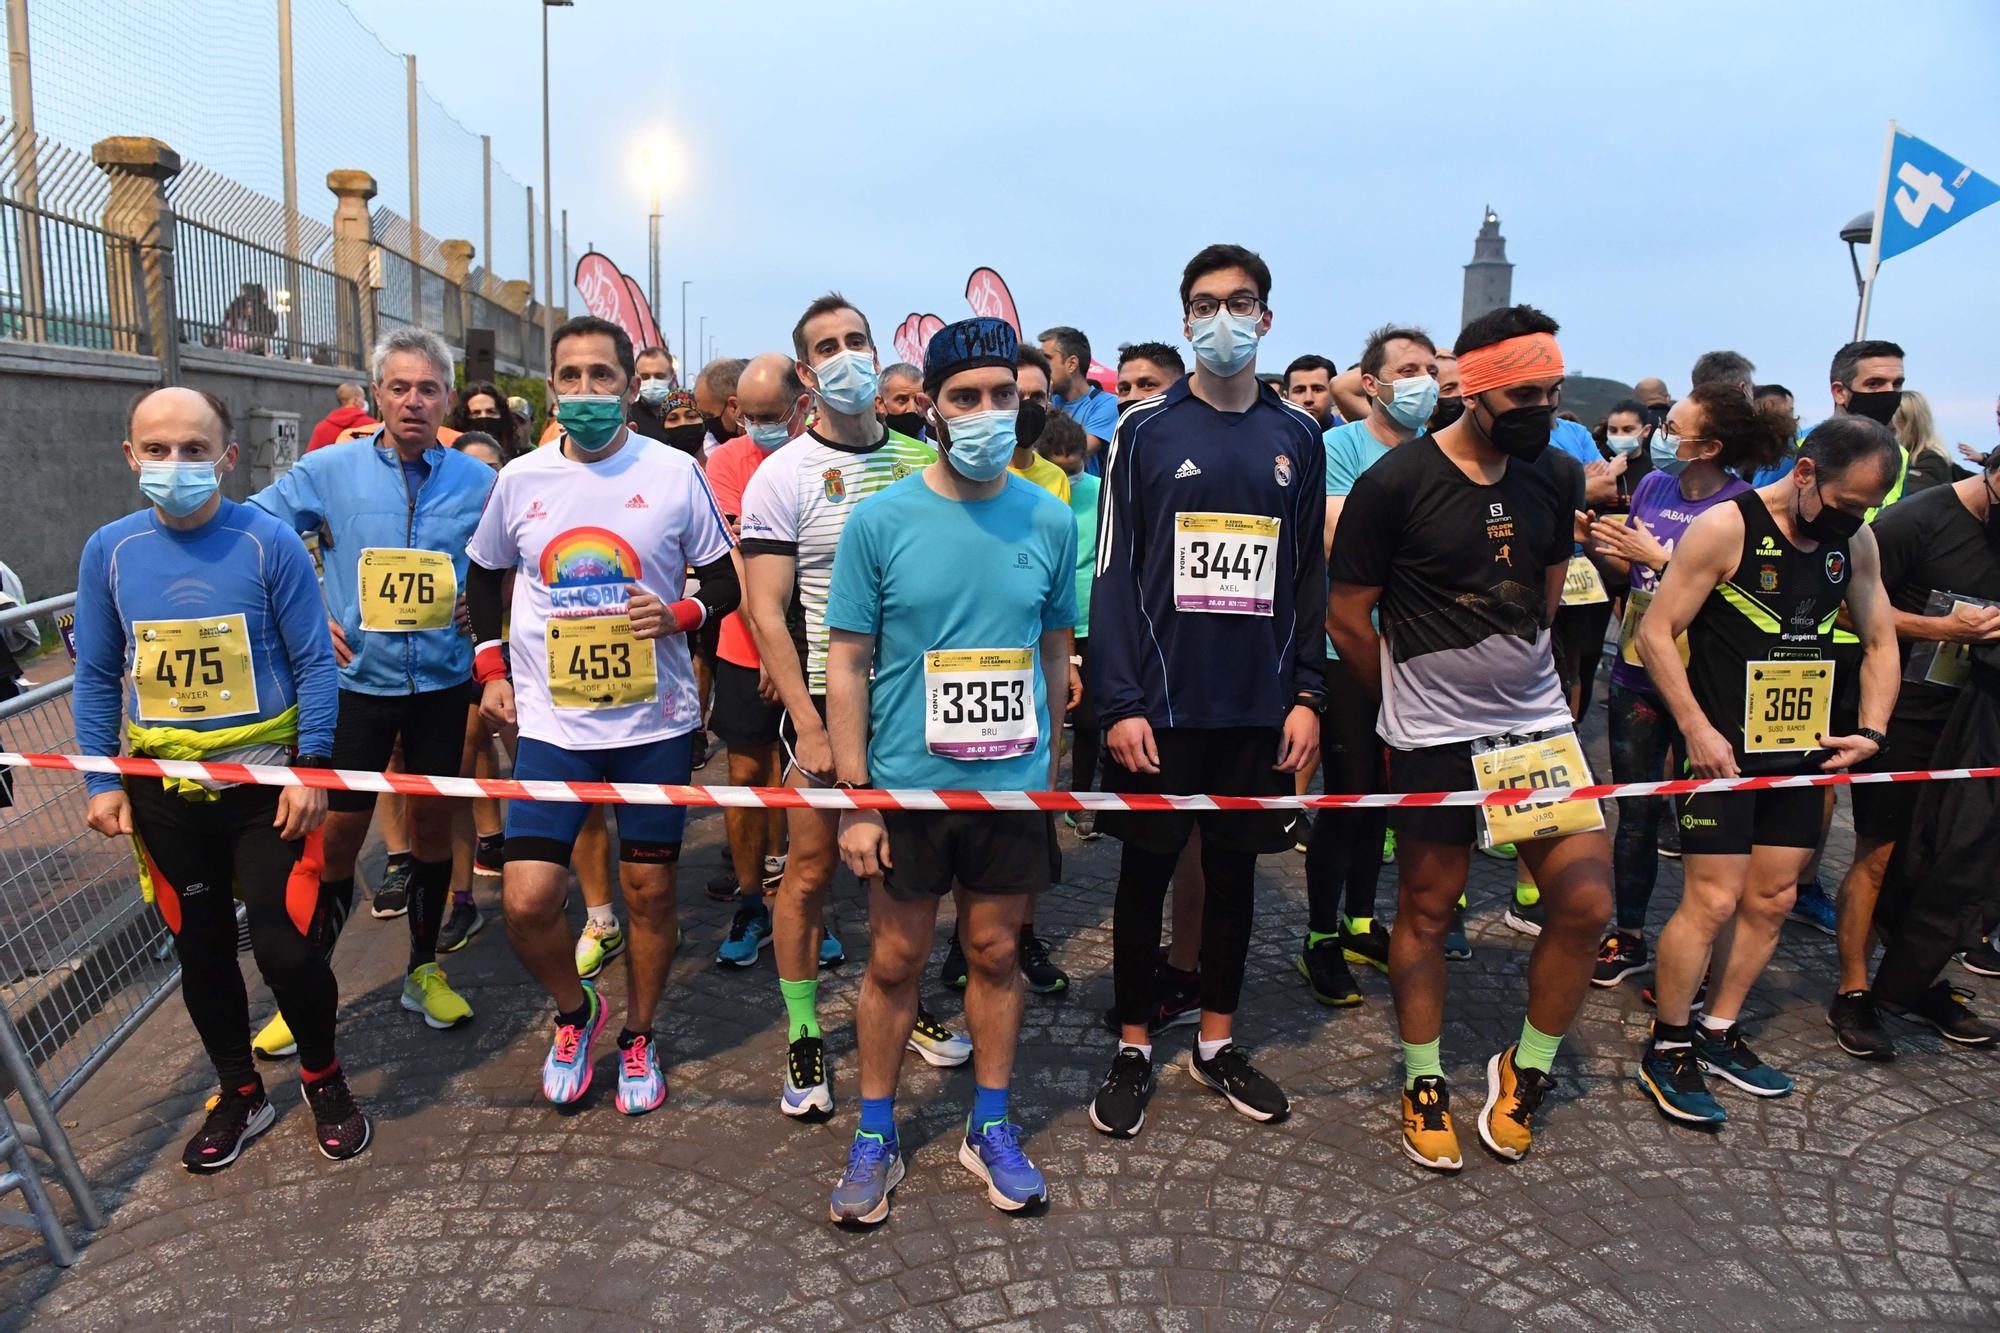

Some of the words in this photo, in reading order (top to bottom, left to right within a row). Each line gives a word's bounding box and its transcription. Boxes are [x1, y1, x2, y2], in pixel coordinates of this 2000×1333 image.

[1174, 468, 1202, 479] adidas
[1487, 529, 1515, 539] TRAIL
[1190, 541, 1268, 581] 3447
[1756, 548, 1782, 556] VIATOR
[379, 572, 434, 604] 476
[1219, 584, 1240, 592] AXEL
[156, 646, 224, 688] 475
[568, 642, 632, 681] 453
[177, 690, 209, 700] JAVIER
[942, 680, 1025, 724] 3353
[1764, 687, 1813, 722] 366
[981, 727, 998, 737] BRU
